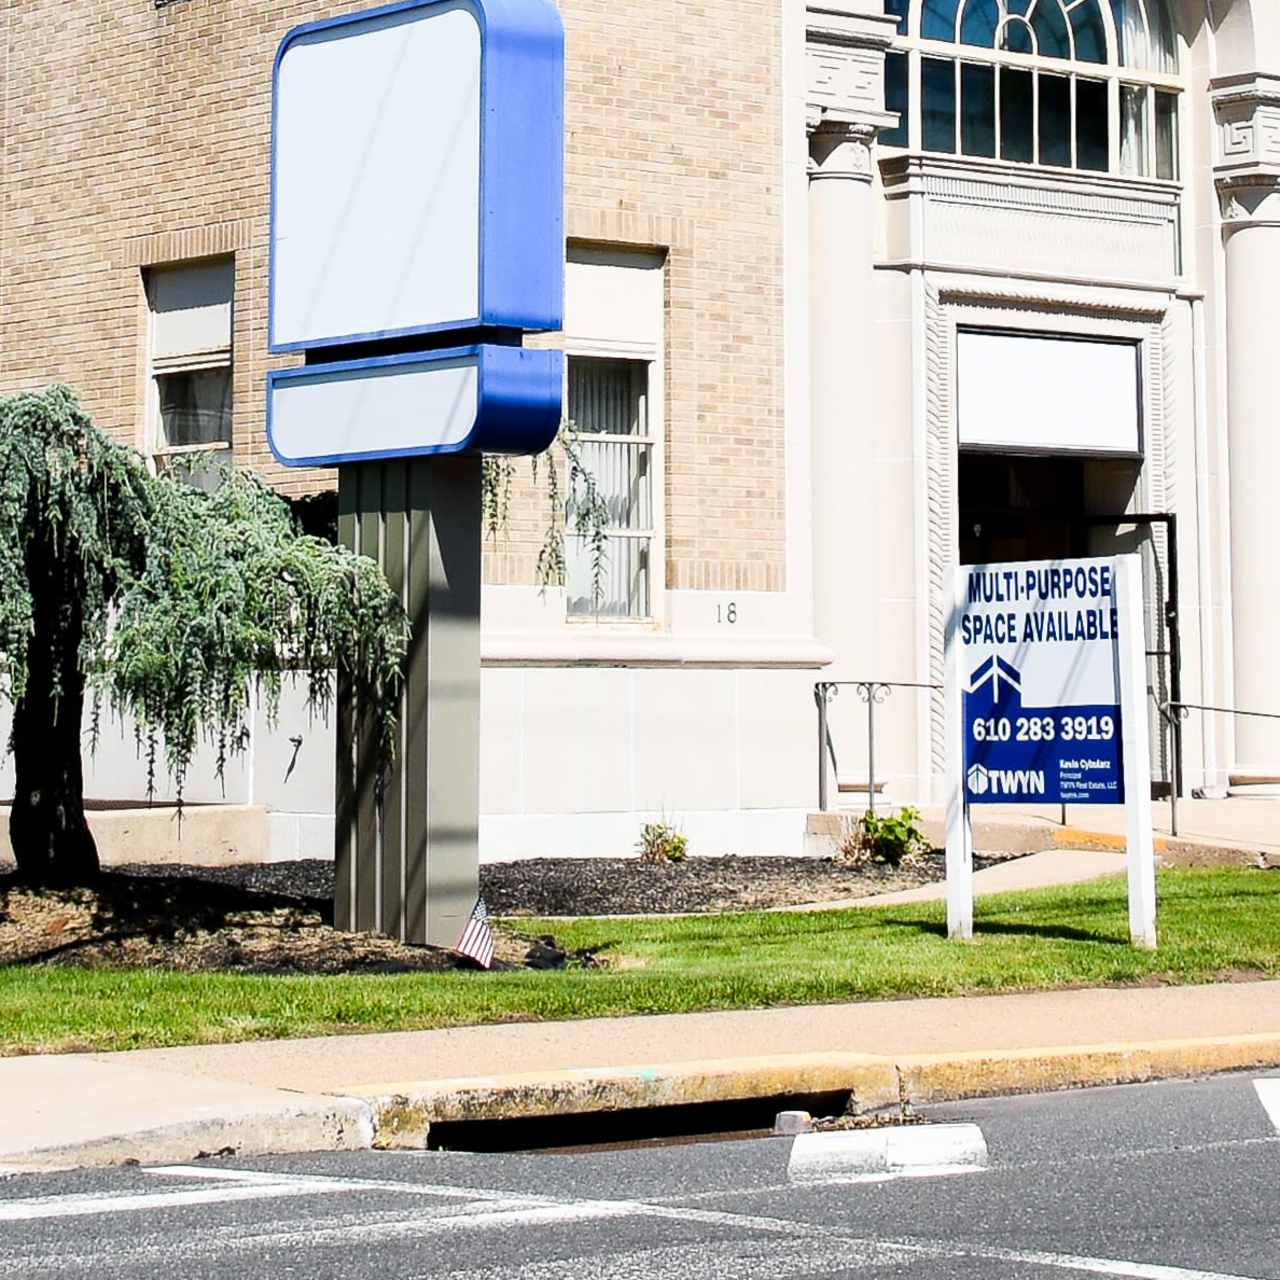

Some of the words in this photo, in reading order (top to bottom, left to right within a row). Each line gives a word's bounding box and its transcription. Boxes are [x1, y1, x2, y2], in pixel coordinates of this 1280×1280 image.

[969, 565, 1112, 603] MULTI-PURPOSE
[962, 612, 1017, 645] SPACE
[1022, 607, 1118, 643] AVAILABLE
[973, 717, 1011, 742] 610
[1016, 716, 1055, 742] 283
[1060, 715, 1114, 741] 3919
[987, 769, 1045, 794] TWYN
